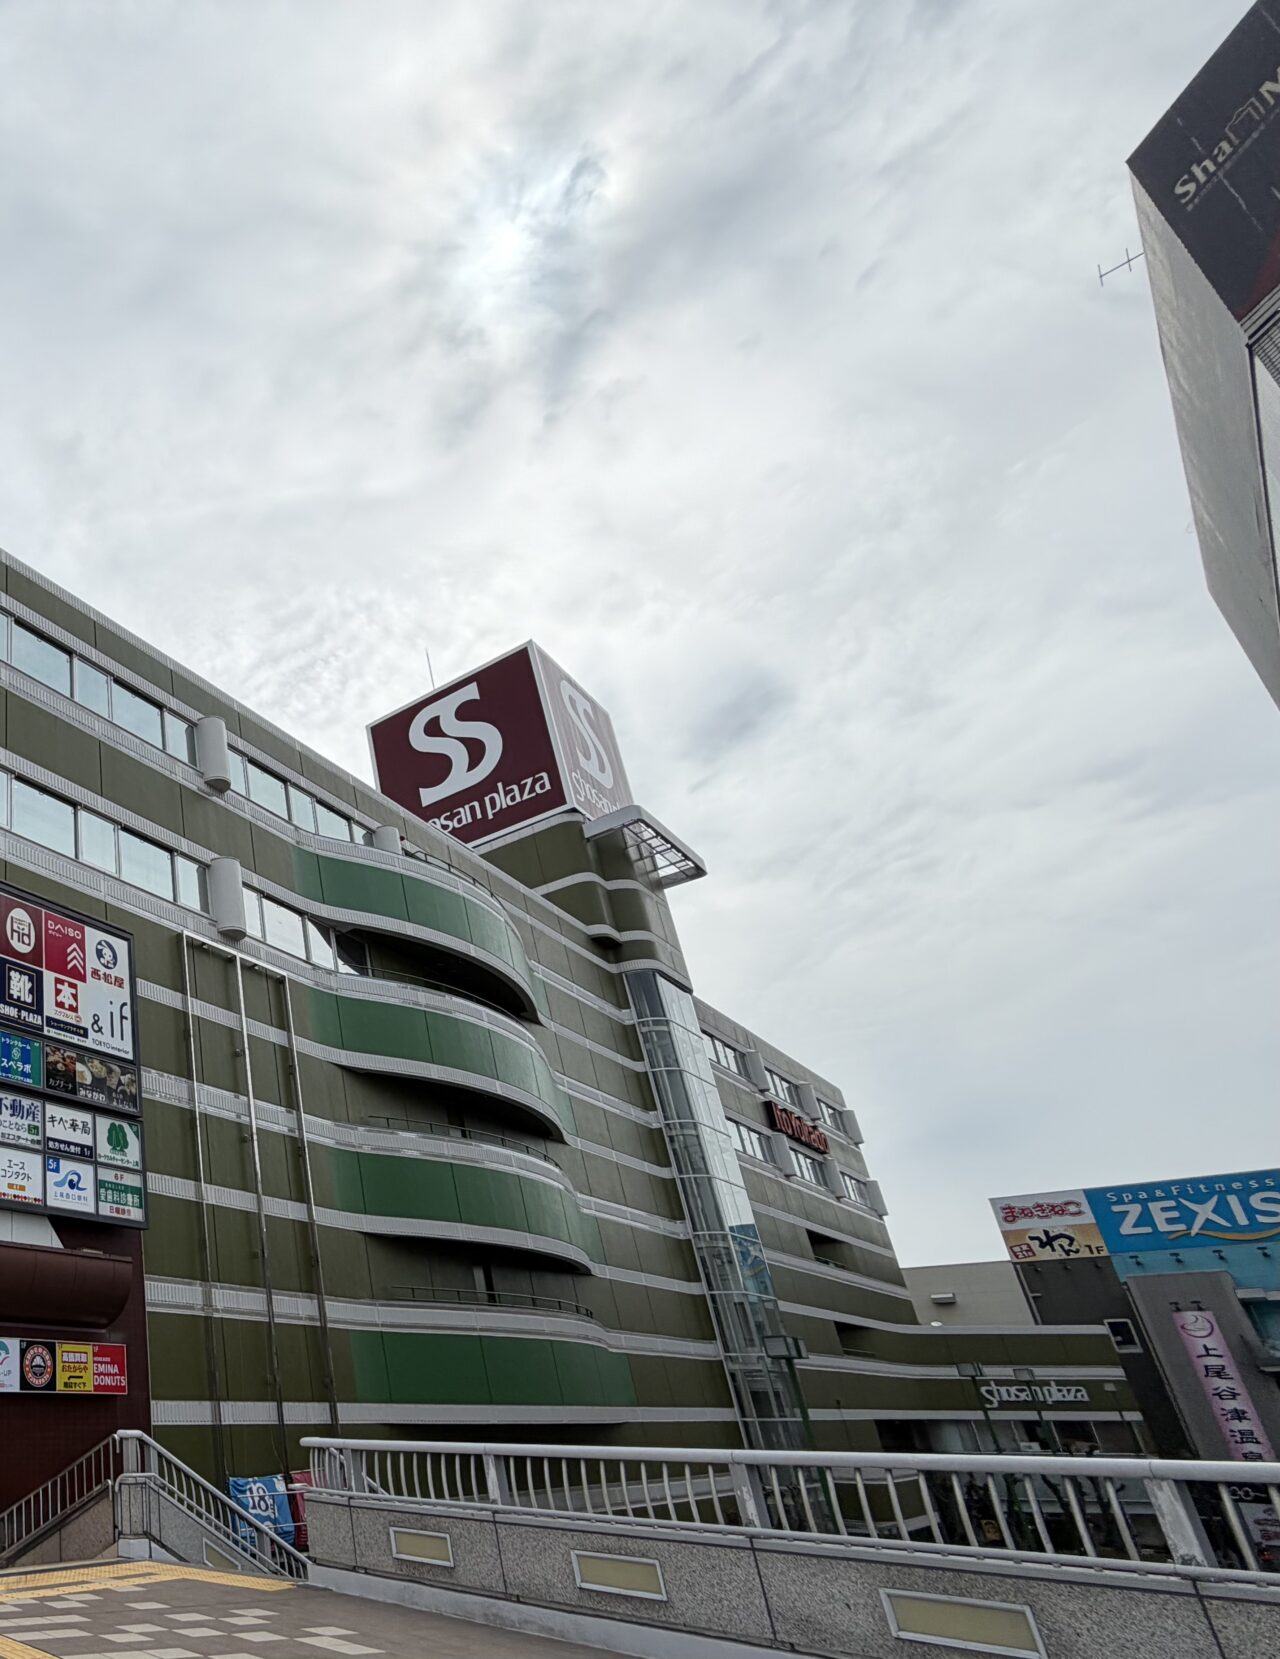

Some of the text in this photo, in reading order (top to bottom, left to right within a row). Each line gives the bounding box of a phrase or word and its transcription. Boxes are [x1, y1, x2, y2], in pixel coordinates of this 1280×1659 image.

[484, 771, 552, 821] plaza
[47, 919, 82, 940] DAISO
[9, 970, 33, 1004] 靴
[90, 967, 125, 989] 西松屋
[56, 981, 77, 1009] 本
[109, 1001, 129, 1041] if
[7, 1159, 26, 1171] エース
[48, 1158, 57, 1170] 5F
[0, 1168, 33, 1183] コンタクト
[1001, 1200, 1086, 1224] まねきねこ
[61, 1364, 89, 1374] おたからや
[93, 1363, 119, 1374] EMINA
[93, 1375, 126, 1387] DONUTS
[980, 1380, 1090, 1409] Shosan plaza
